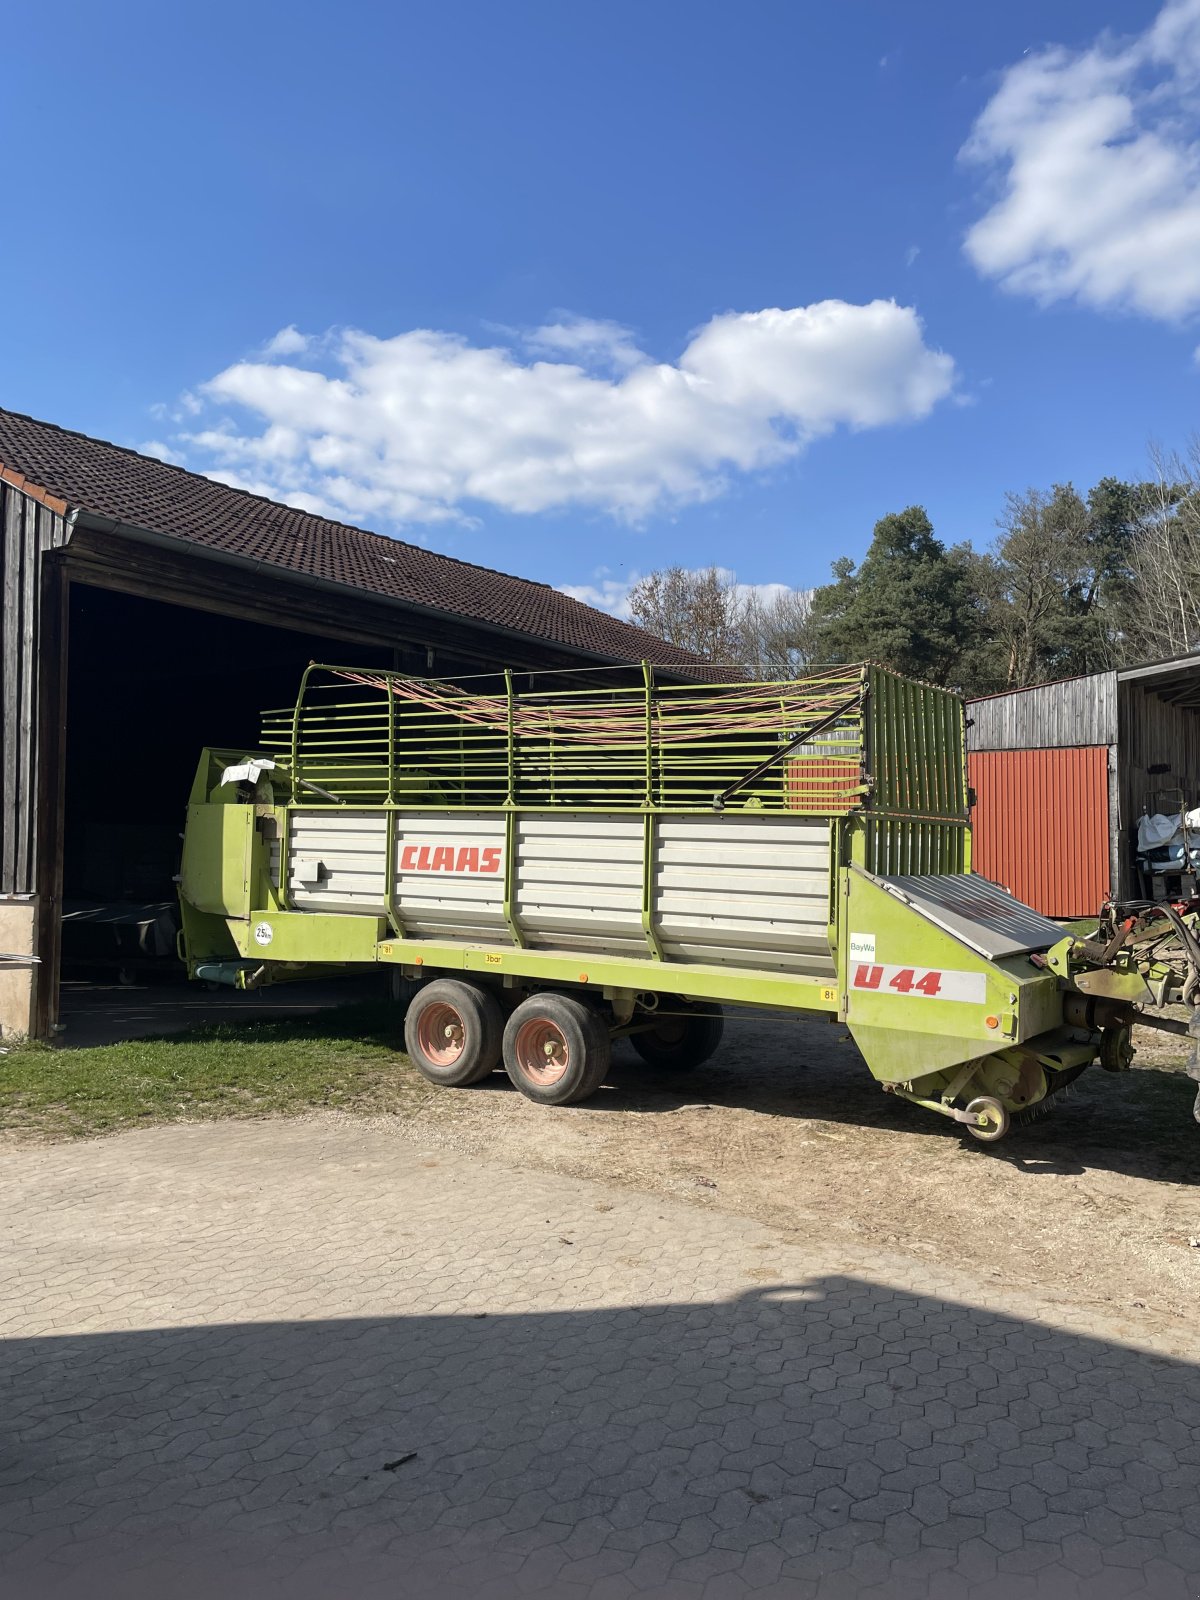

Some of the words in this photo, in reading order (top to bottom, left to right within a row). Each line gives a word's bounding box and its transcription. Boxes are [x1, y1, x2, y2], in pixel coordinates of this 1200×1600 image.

[400, 846, 502, 872] CLAAS
[850, 942, 875, 952] BayWa
[853, 964, 884, 989] U
[889, 969, 942, 996] 44
